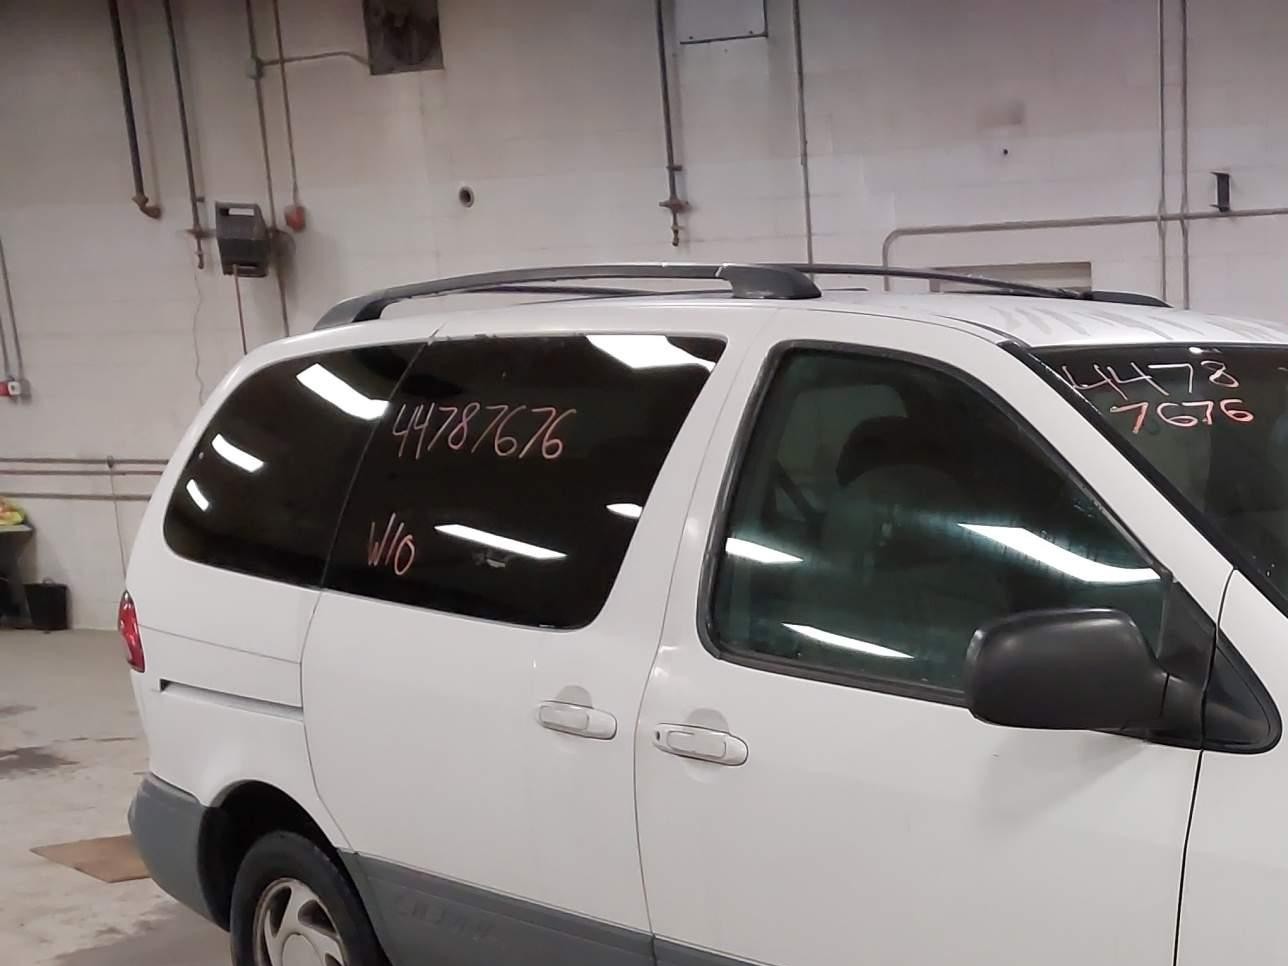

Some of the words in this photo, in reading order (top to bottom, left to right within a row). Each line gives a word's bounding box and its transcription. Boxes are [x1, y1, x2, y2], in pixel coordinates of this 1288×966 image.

[1062, 360, 1239, 400] 4478
[392, 402, 577, 460] 44787676
[1110, 399, 1254, 434] 7676
